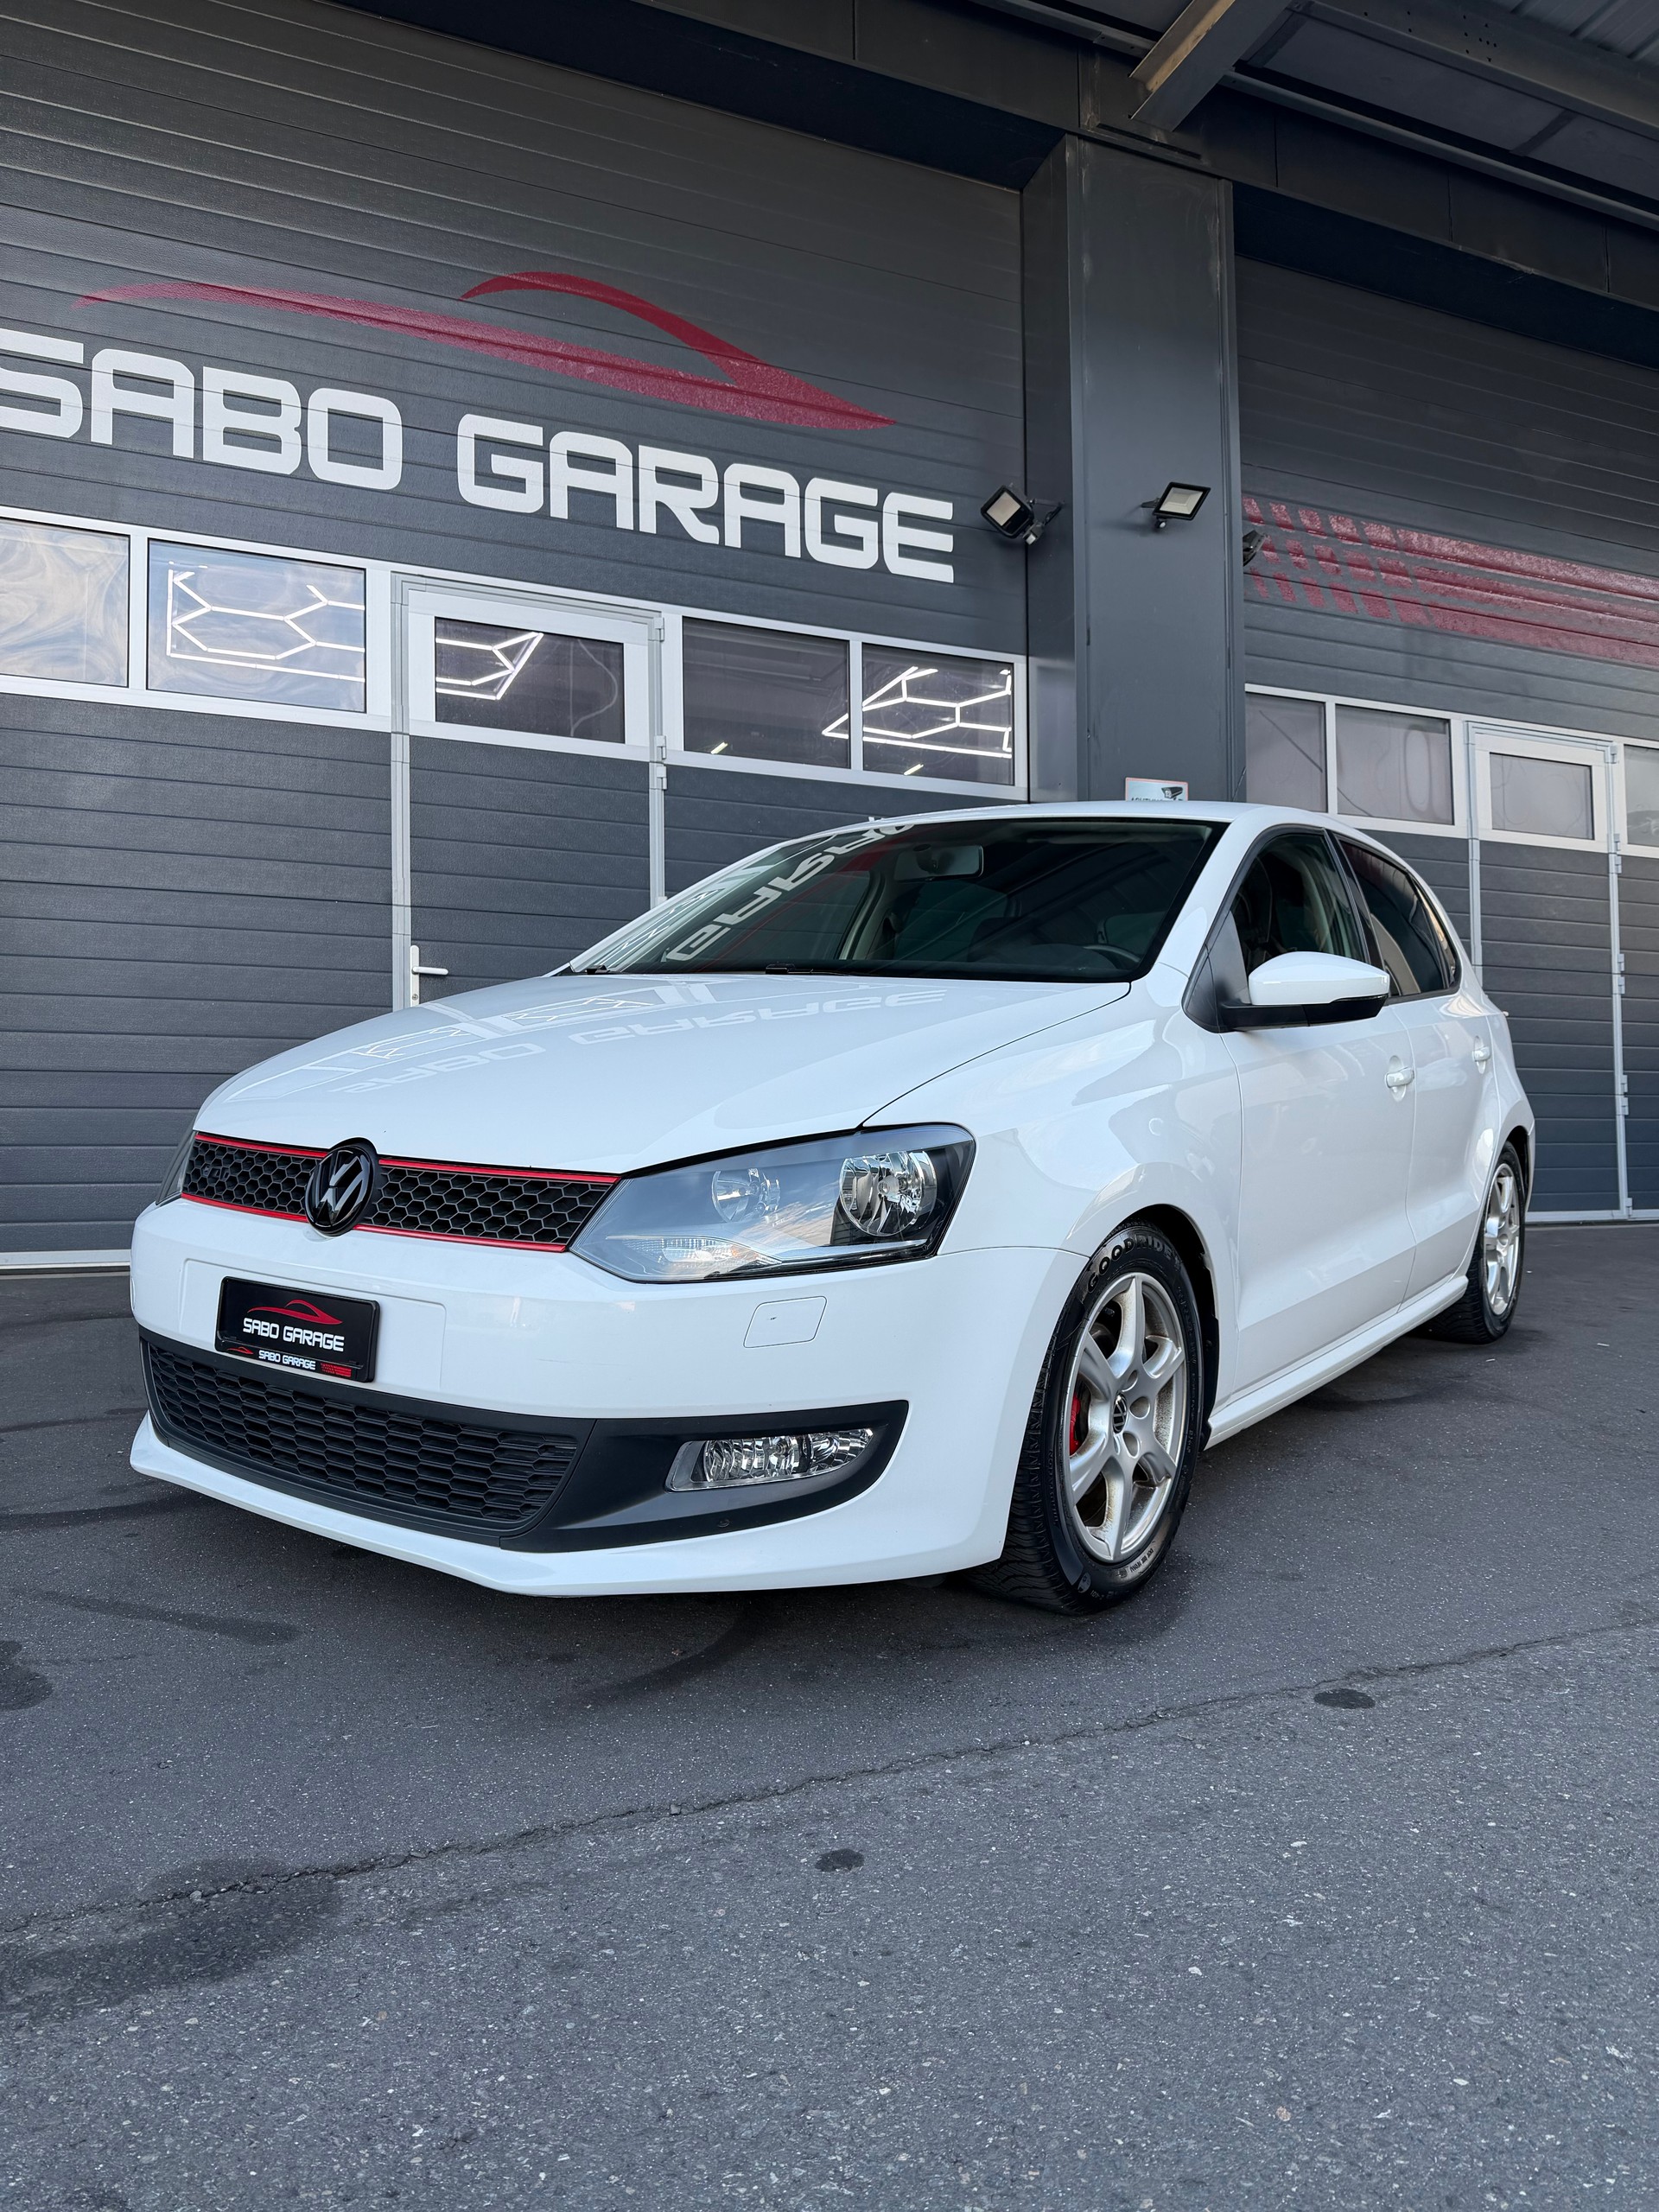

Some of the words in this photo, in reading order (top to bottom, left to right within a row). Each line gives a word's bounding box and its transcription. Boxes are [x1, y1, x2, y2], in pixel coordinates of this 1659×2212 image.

[0, 327, 403, 490] SABO
[457, 413, 954, 583] GARAGE
[243, 1318, 280, 1339] SABO
[283, 1325, 345, 1352] GARAGE
[258, 1350, 281, 1363] SABO
[282, 1356, 316, 1370] GARAGE
